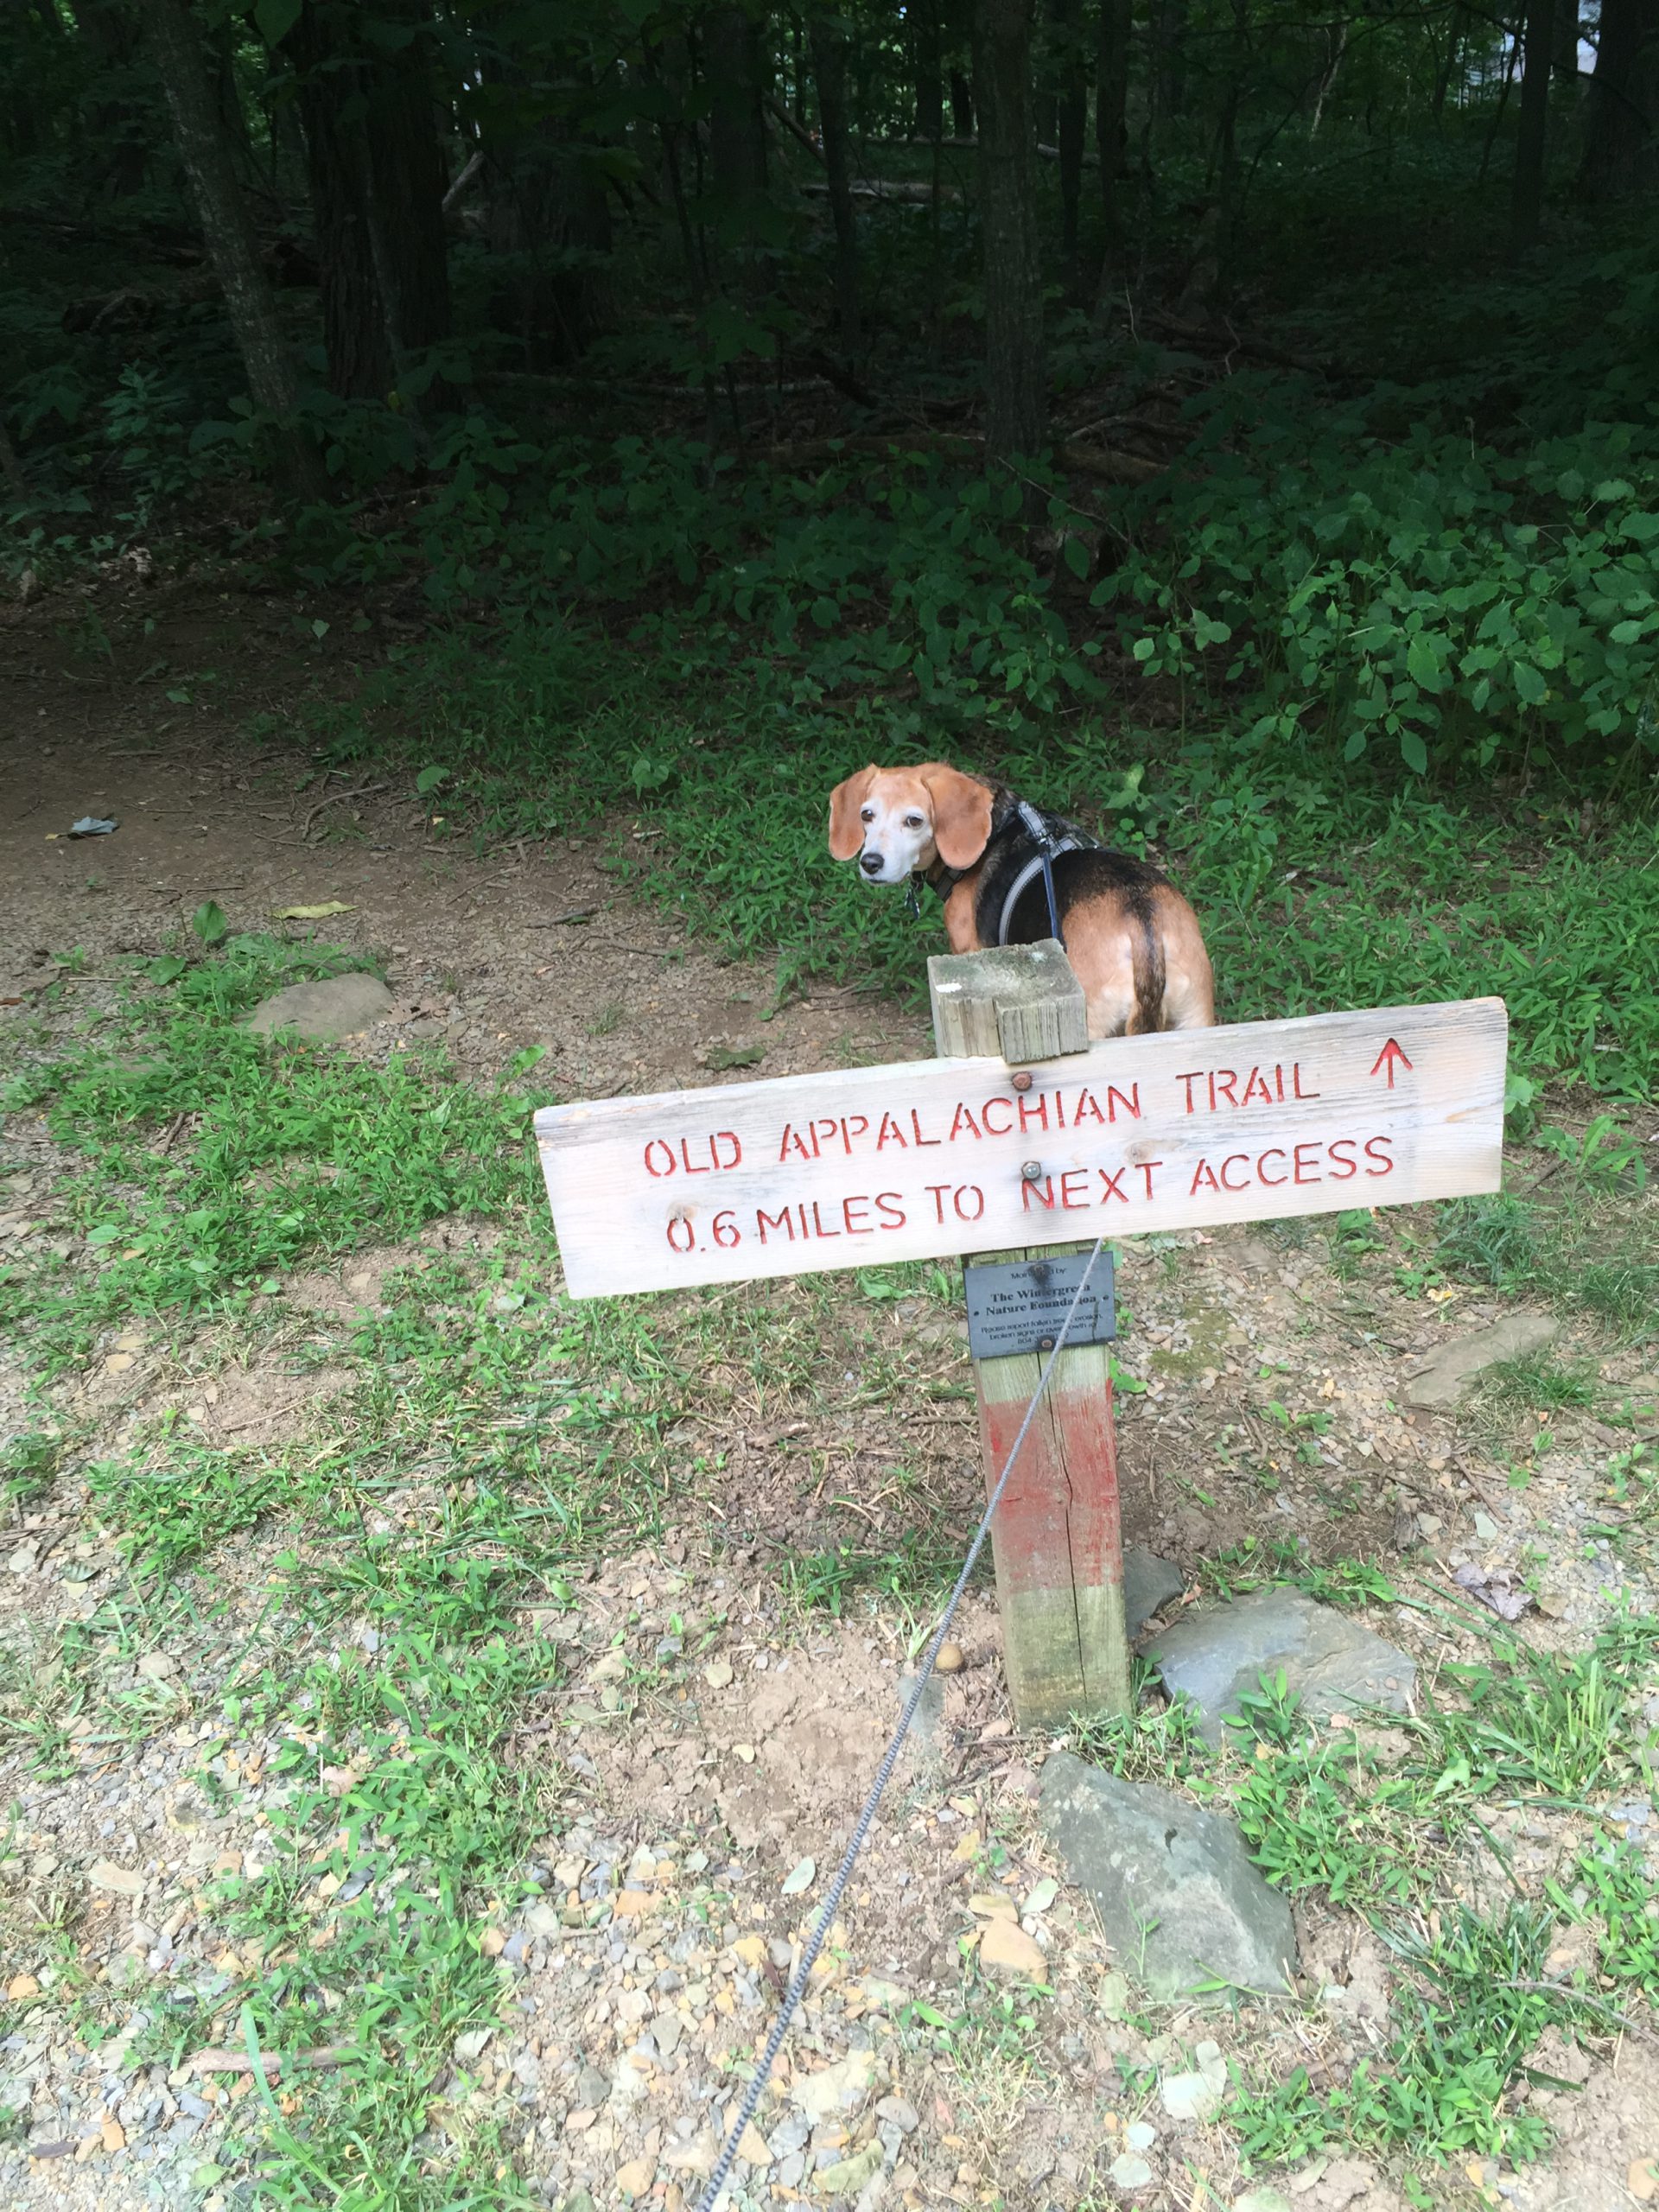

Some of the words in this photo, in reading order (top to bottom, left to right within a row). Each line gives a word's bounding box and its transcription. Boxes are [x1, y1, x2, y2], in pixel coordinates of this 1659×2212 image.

[644, 1131, 742, 1177] OLD
[779, 1084, 1141, 1162] APPALACHIAN
[1176, 1063, 1320, 1115] TRAIL
[666, 1210, 741, 1253] 0.6
[757, 1192, 906, 1245] MILES
[925, 1185, 985, 1224] TO
[1021, 1161, 1163, 1211] NEXT
[1190, 1136, 1395, 1197] ACCESS
[986, 1305, 1027, 1317] Nature
[990, 1293, 1014, 1303] The
